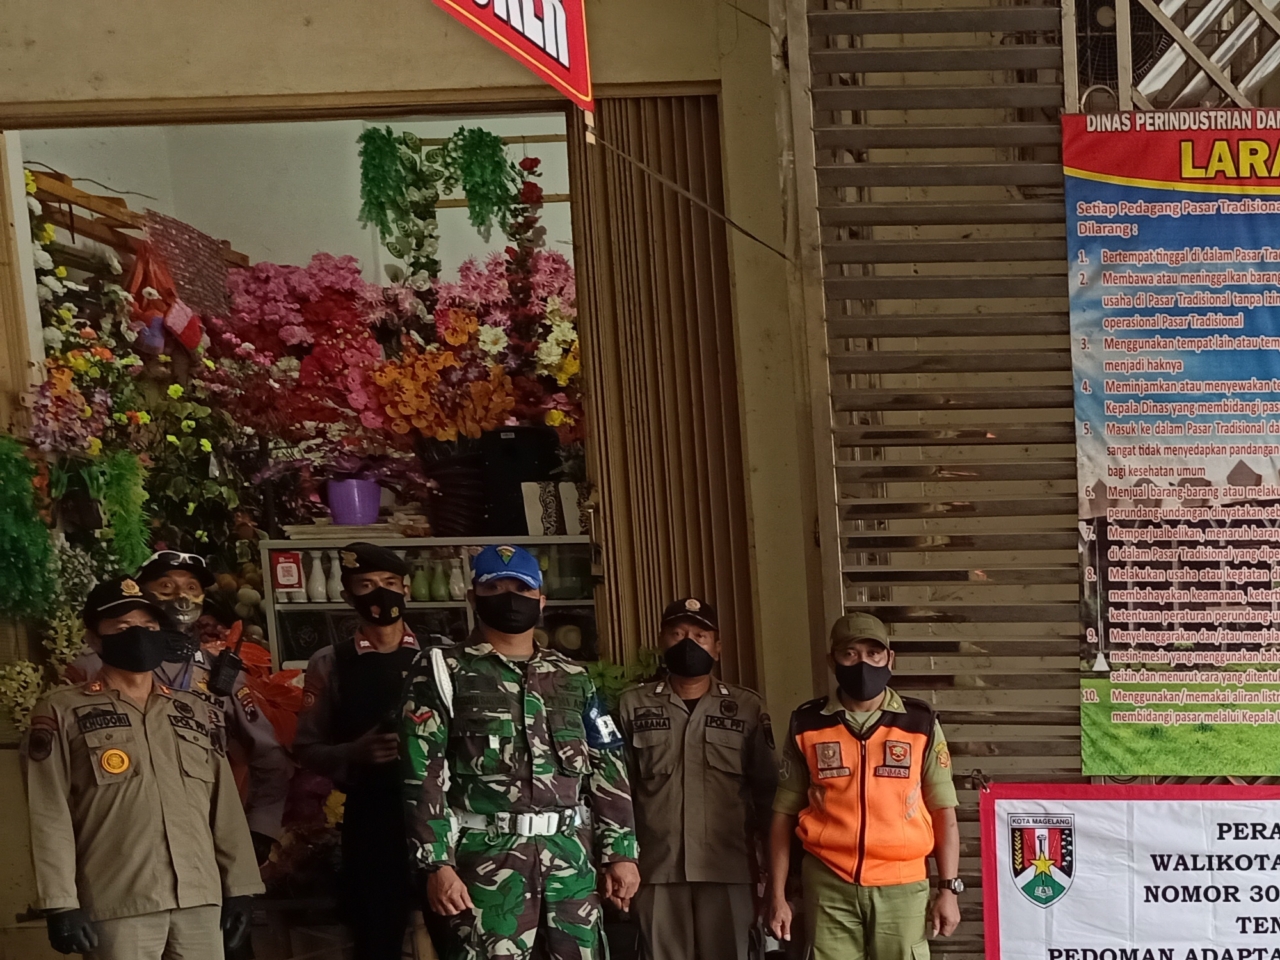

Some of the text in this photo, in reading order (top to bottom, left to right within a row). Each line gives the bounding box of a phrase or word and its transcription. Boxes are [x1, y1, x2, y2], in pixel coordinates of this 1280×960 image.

[1086, 113, 1131, 132] DINAS
[1135, 111, 1251, 131] PERINDUSTRIAN
[1077, 200, 1117, 218] Setiap
[1118, 199, 1180, 218] Pedagang
[1182, 200, 1218, 215] Pasar
[1077, 222, 1131, 238] Dilarang
[1078, 250, 1089, 264] 1.
[1101, 249, 1154, 267] Bertempat
[1155, 248, 1189, 266] tinggal
[1191, 247, 1201, 262] di
[1202, 247, 1233, 262] dalam
[1234, 248, 1262, 262] Pasar
[1079, 273, 1089, 286] 2.
[1102, 271, 1156, 286] Membawa
[1157, 272, 1179, 285] atau
[1180, 269, 1248, 288] meninggalkan
[1107, 464, 1206, 480] bagi kesehatan umum
[1107, 525, 1205, 542] Memperjualbelikan,
[1206, 525, 1251, 540] menaruh
[1109, 607, 1161, 623] ketentuan
[1162, 609, 1213, 626] peraturan
[1083, 690, 1099, 702] 10.
[1111, 688, 1230, 705] Menggunakan/memakai
[1232, 689, 1260, 703] aliran
[710, 718, 727, 728] POL
[1112, 710, 1174, 725] membidangi
[1175, 713, 1201, 725] pasar
[1203, 710, 1240, 723] melalui
[1241, 710, 1275, 726] Kepala
[877, 767, 907, 777] LINMAS
[1143, 885, 1241, 903] NOMOR
[1249, 885, 1280, 903] 30
